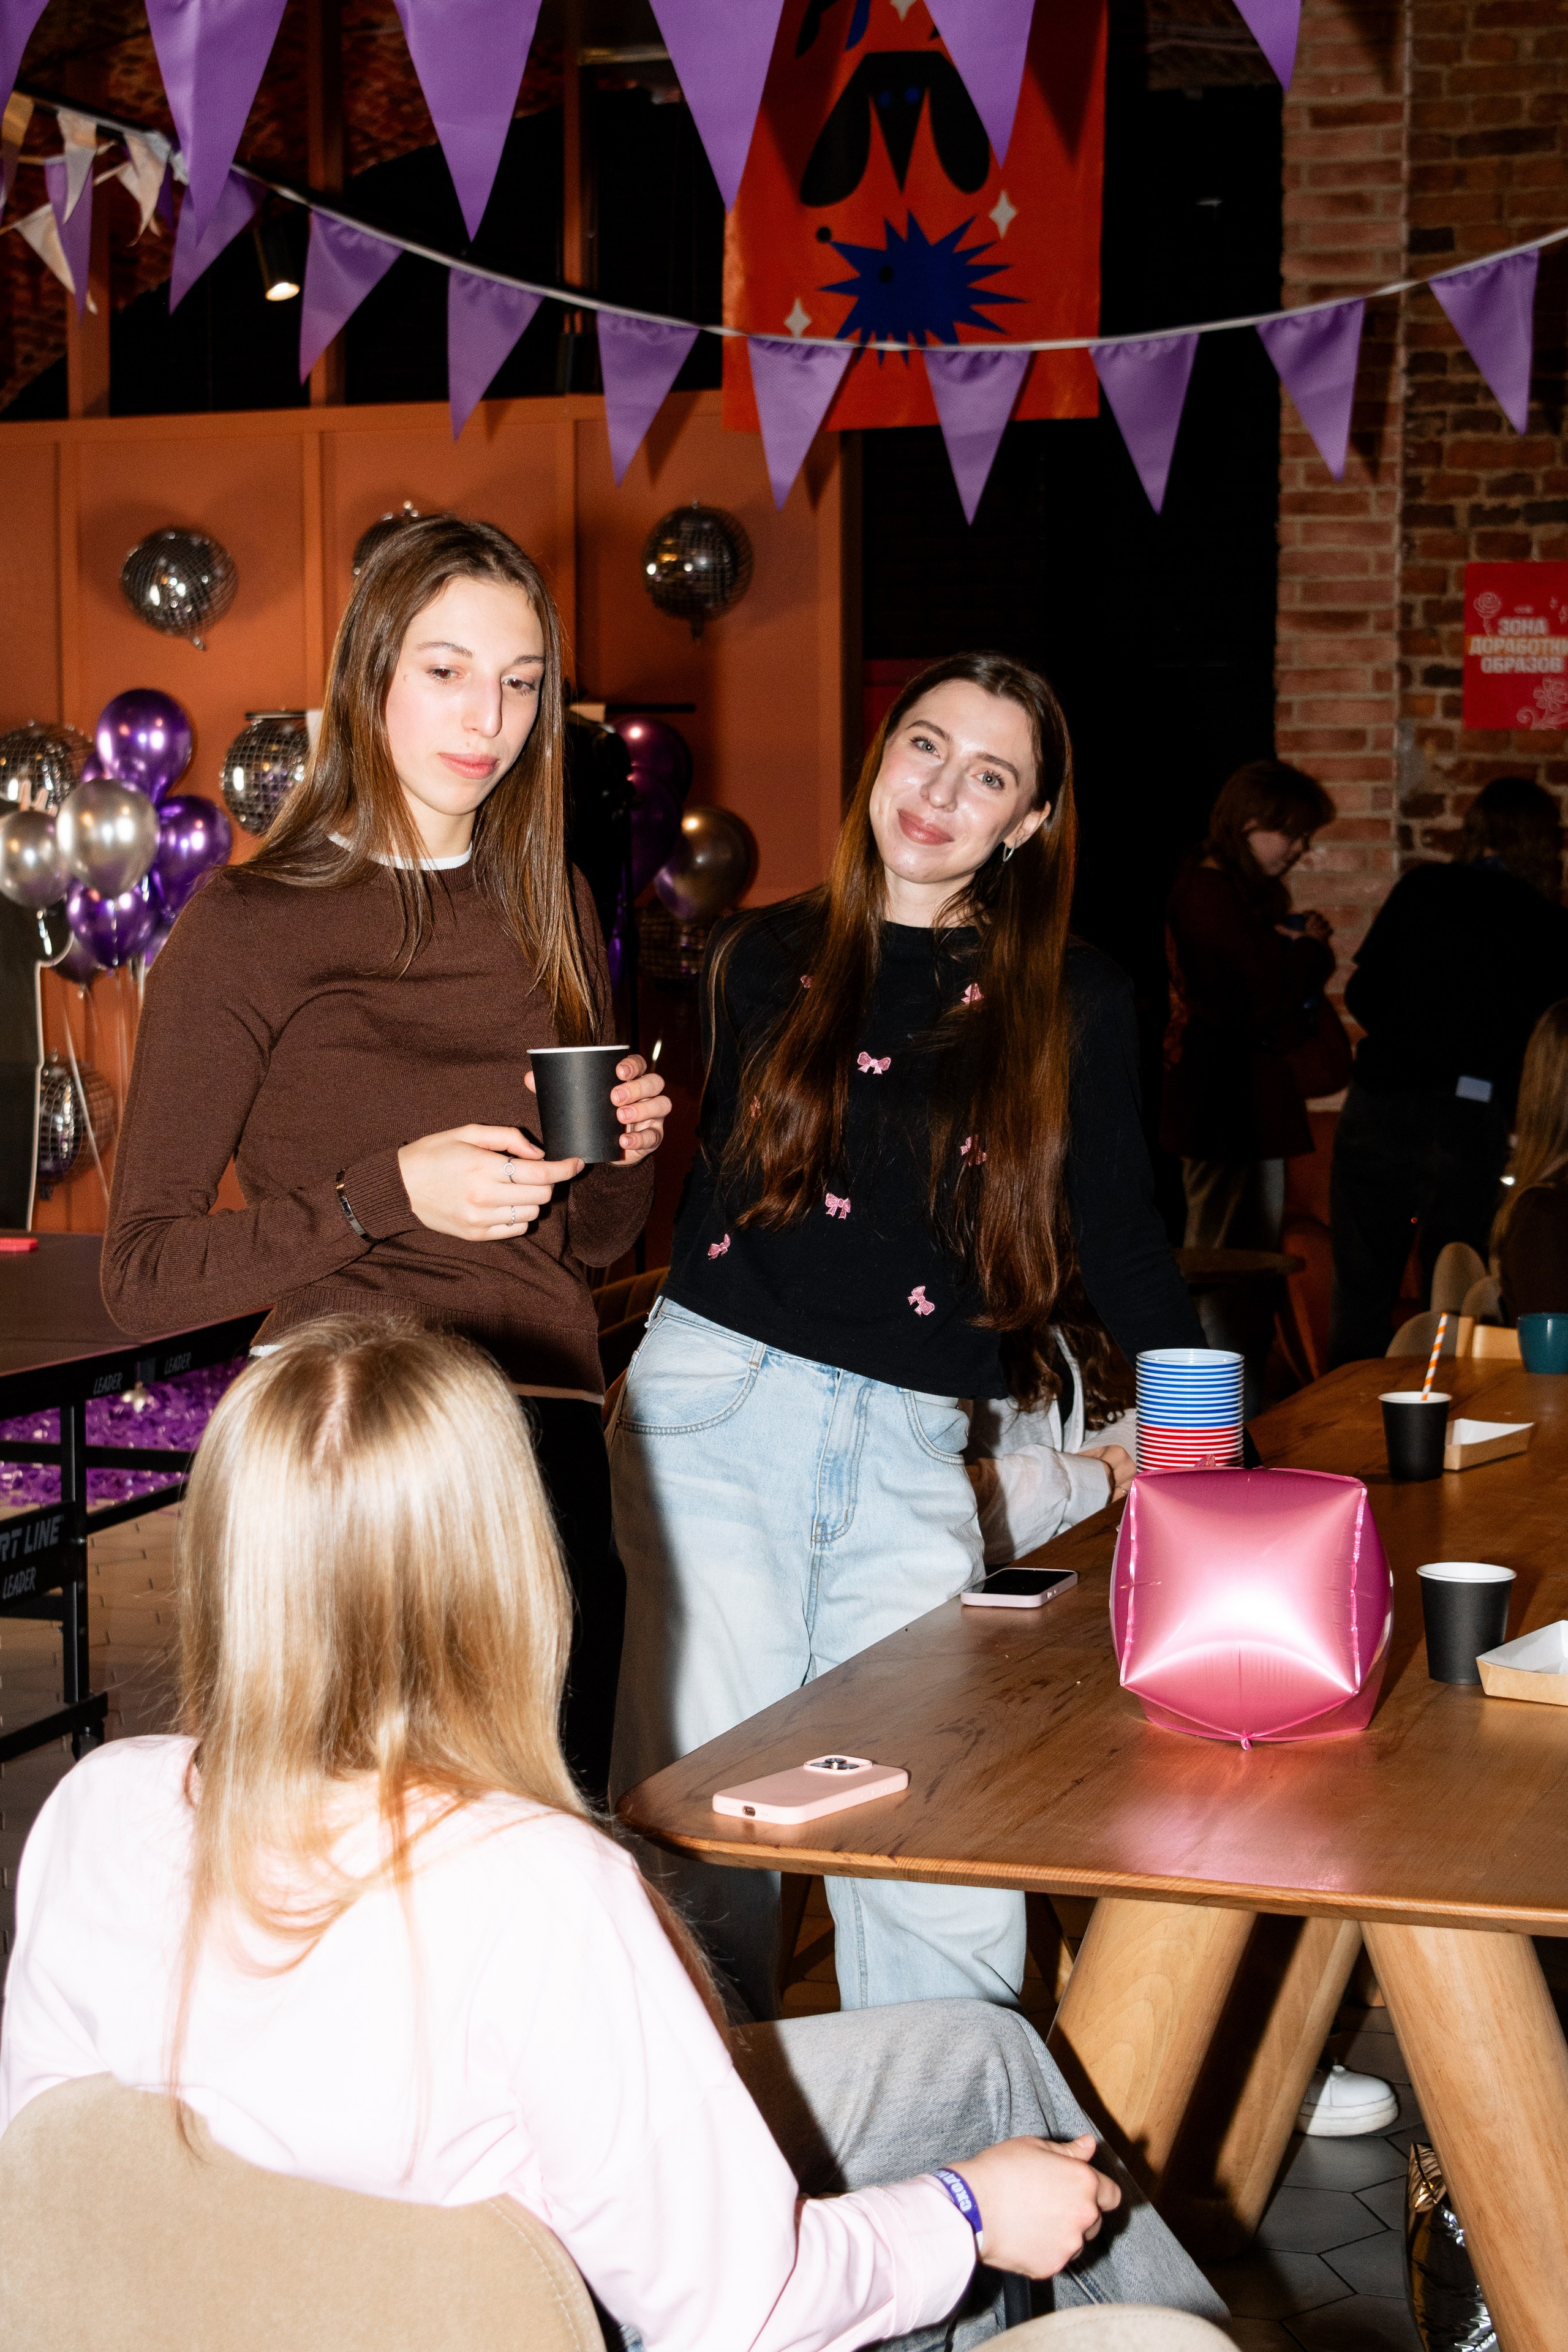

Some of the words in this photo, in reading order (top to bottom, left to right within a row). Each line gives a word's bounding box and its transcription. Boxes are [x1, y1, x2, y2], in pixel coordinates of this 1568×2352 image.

[1498, 617, 1548, 635] ЗОНА
[164, 1352, 192, 1376] LEADER
[93, 1371, 123, 1395] LEADER
[24, 1515, 62, 1555] LINE
[2, 1566, 37, 1600] LEADER
